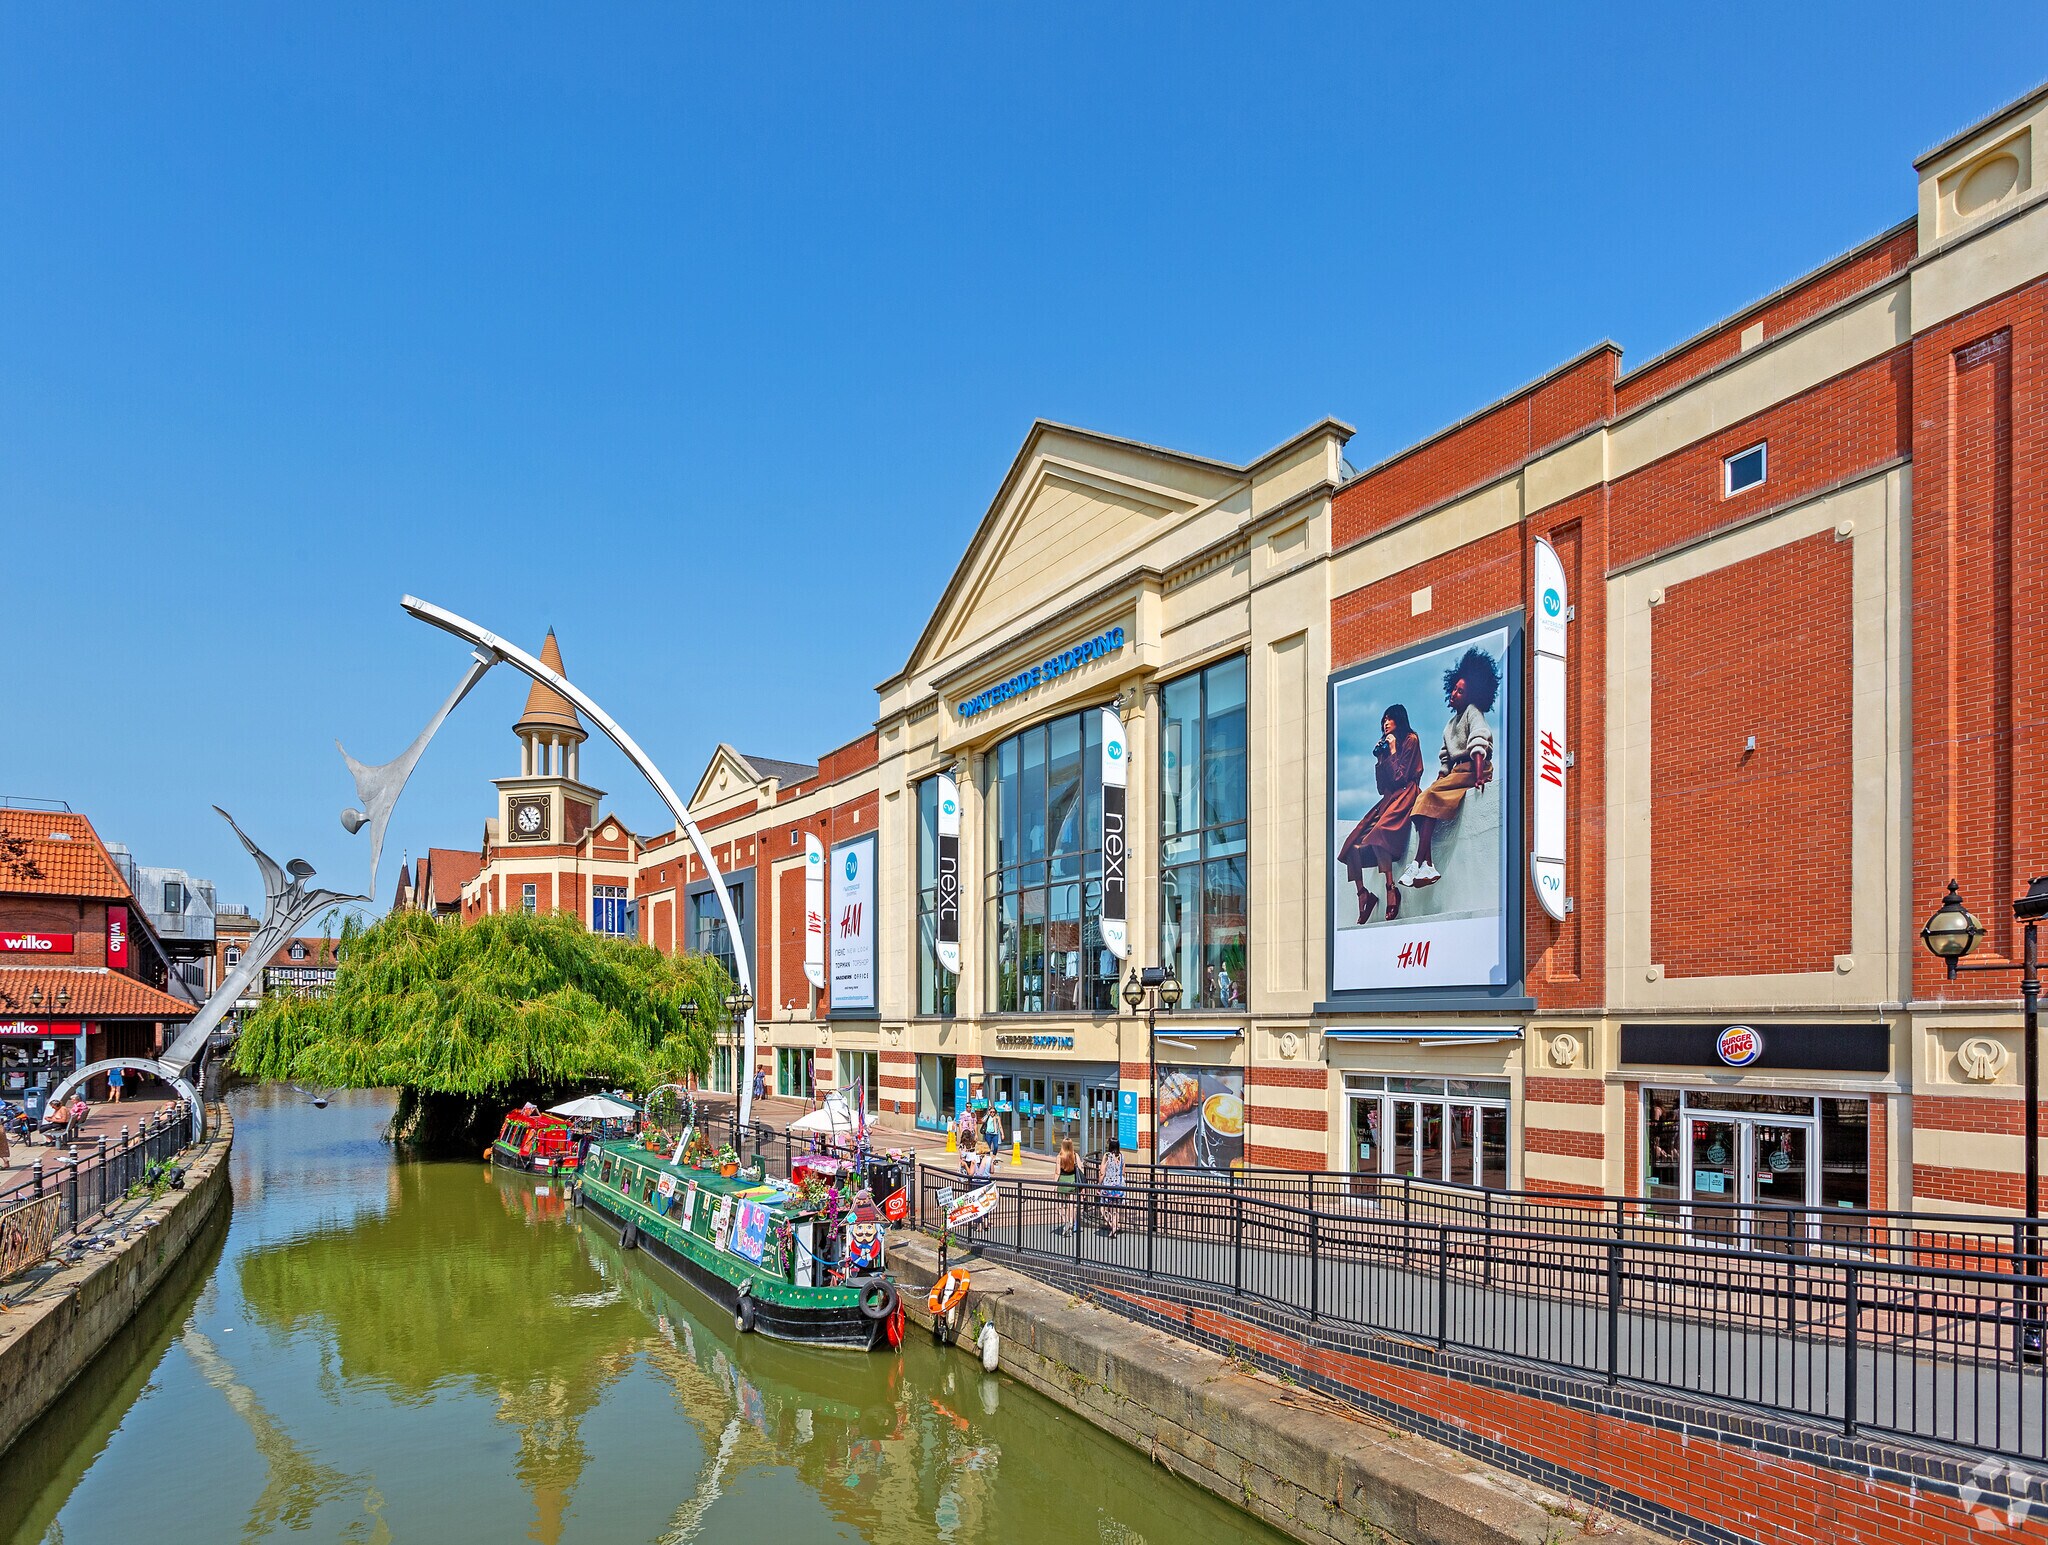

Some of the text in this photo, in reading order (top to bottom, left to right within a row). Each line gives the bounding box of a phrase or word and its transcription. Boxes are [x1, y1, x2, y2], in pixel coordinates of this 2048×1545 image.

[957, 627, 1125, 719] WATERSIDE SHOPPING
[1540, 730, 1562, 788] H&M
[1105, 812, 1125, 893] next
[941, 857, 957, 921] next
[807, 911, 821, 934] H&M
[840, 902, 863, 939] H&M
[4, 935, 53, 950] wilko
[110, 922, 126, 952] wilko
[1397, 940, 1431, 969] H&M
[0, 1021, 39, 1034] wilko
[1033, 1035, 1074, 1048] SHOPPING
[1721, 1033, 1753, 1057] BURGER KING
